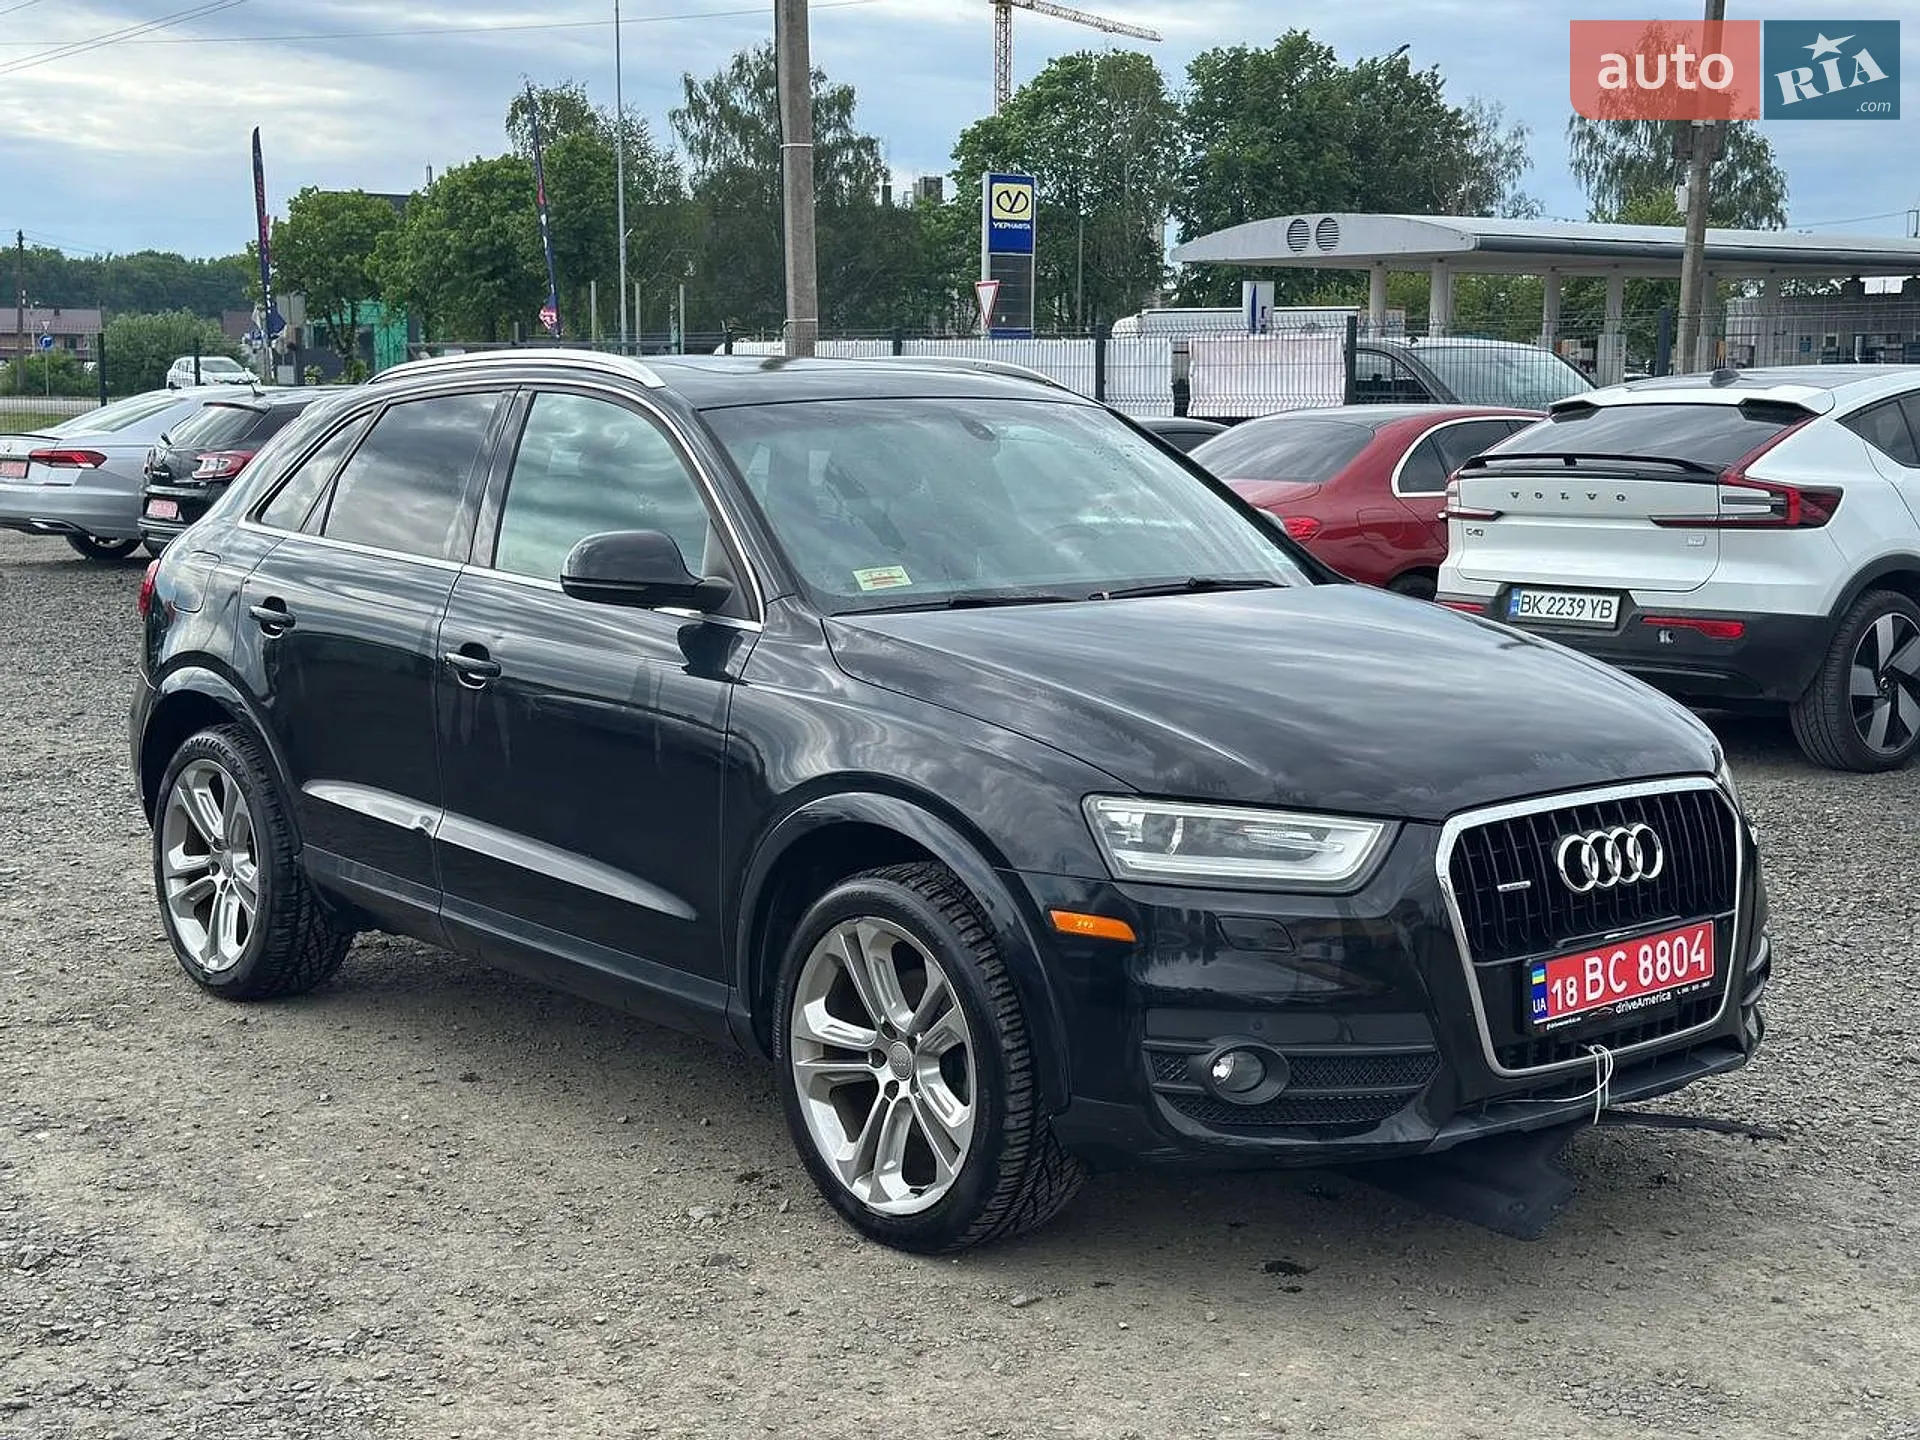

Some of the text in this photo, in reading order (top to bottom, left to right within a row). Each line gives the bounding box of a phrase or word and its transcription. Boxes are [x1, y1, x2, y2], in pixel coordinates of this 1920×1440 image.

[1511, 491, 1626, 502] VOLVO
[1520, 595, 1543, 615] BK
[1546, 596, 1586, 617] 2239
[1591, 598, 1613, 619] YB
[1551, 930, 1706, 1011] 18 BC 8804
[1532, 997, 1547, 1013] UA
[1615, 990, 1672, 1015] driveAmerica
